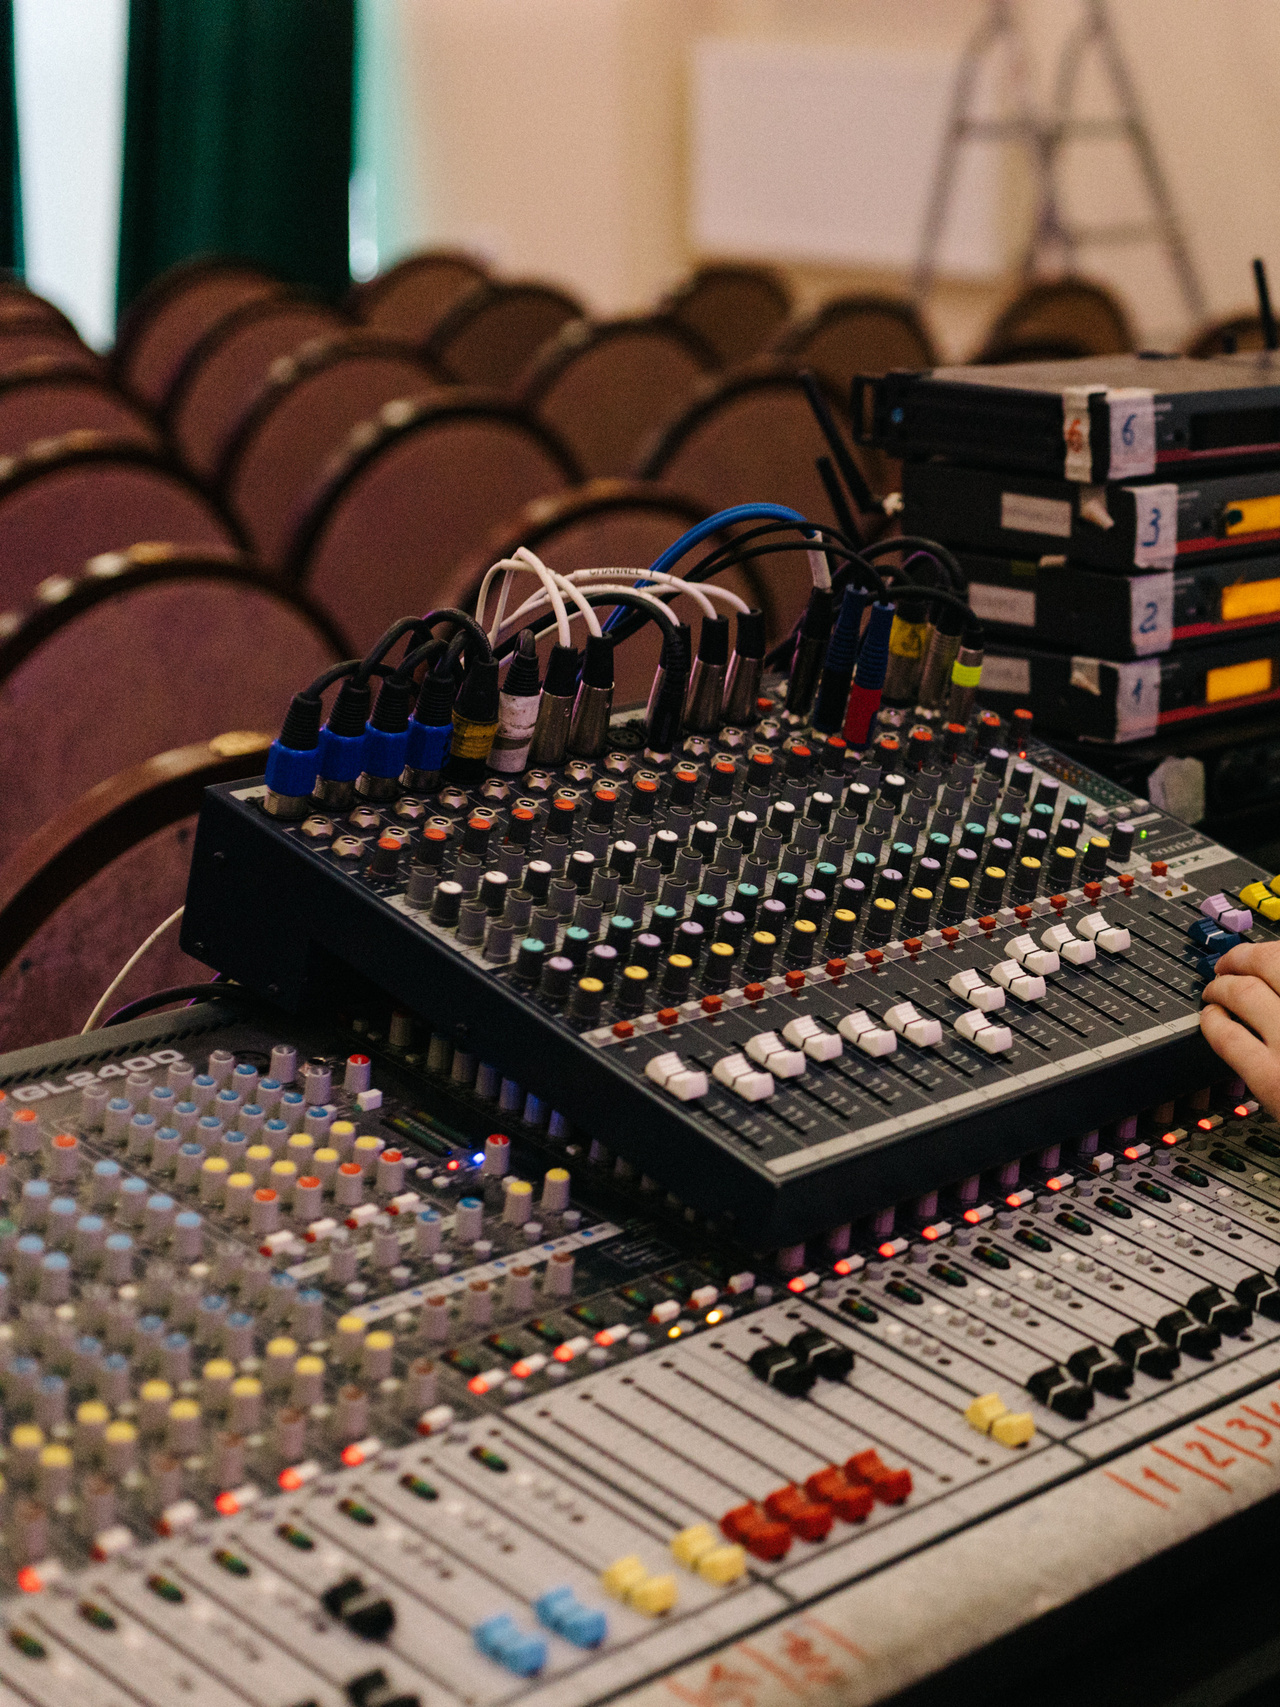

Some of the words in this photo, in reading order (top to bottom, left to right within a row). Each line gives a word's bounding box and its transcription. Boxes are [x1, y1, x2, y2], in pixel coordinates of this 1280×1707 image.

[1122, 413, 1137, 446] 6
[1141, 506, 1161, 548] 3
[1138, 602, 1158, 634] 2
[11, 1049, 185, 1102] GL2400
[1184, 1441, 1236, 1469] 2
[1225, 1418, 1273, 1448] 3
